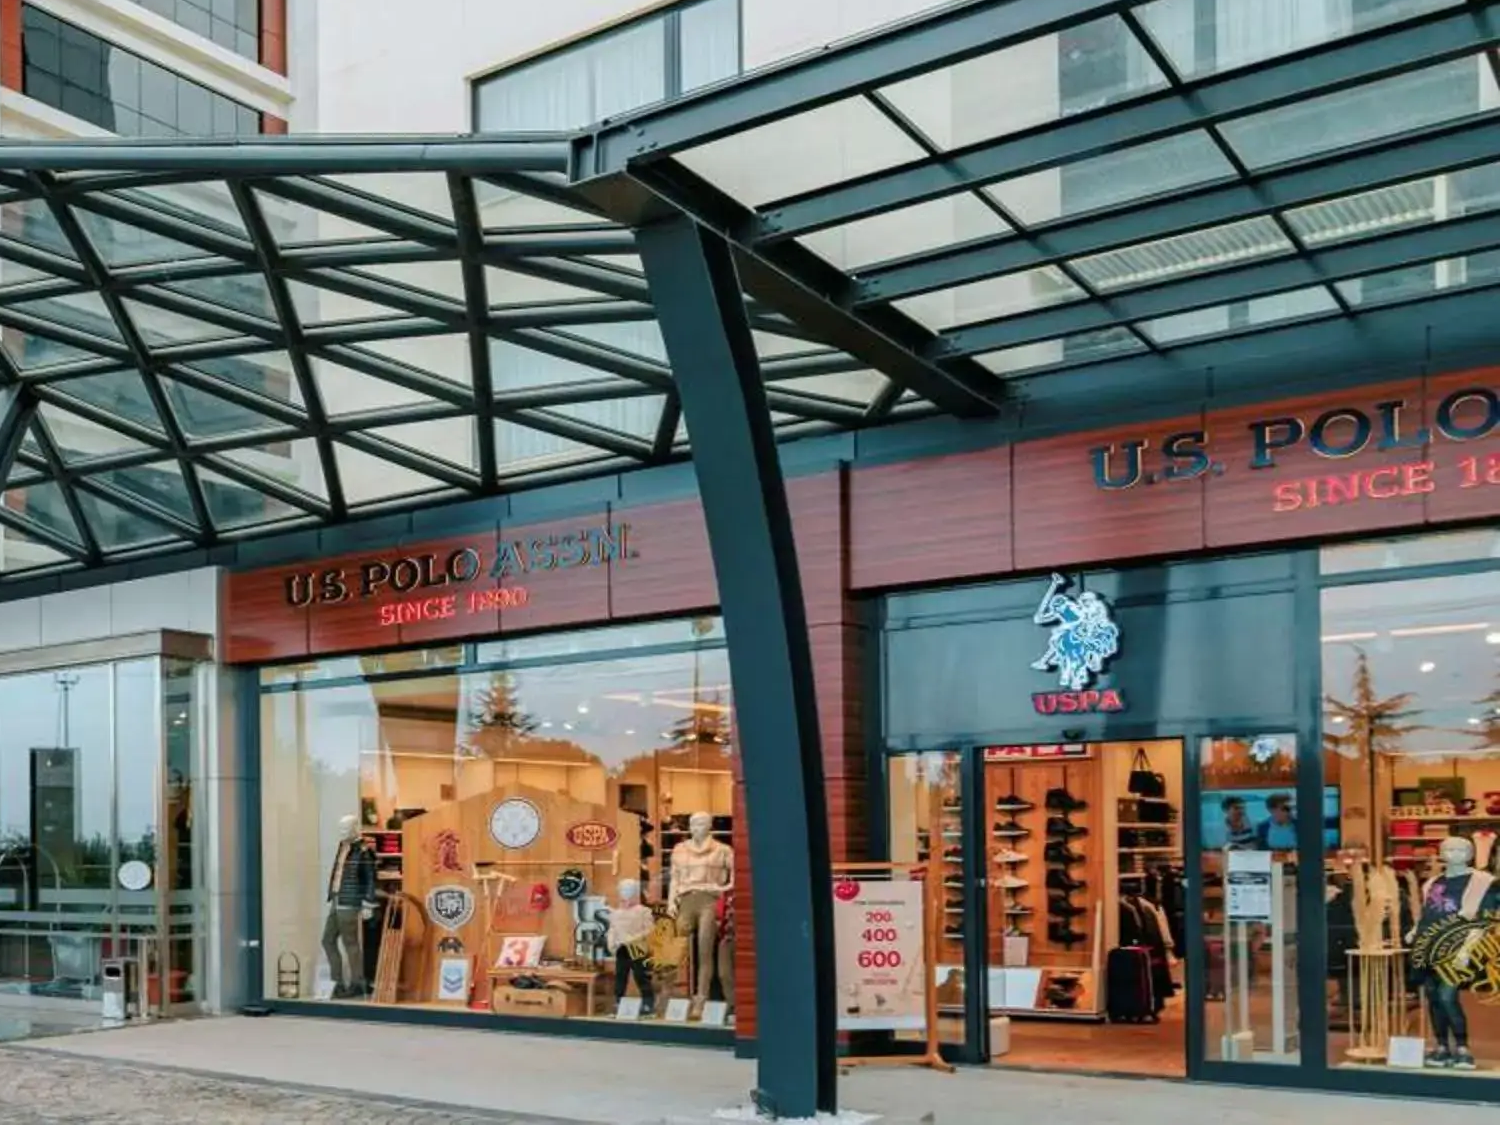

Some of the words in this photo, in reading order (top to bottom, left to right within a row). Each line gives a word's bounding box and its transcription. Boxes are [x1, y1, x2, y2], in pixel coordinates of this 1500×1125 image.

[1090, 430, 1227, 490] U.S.
[1248, 386, 1500, 471] POLO
[1273, 461, 1436, 512] SINCE
[360, 548, 481, 597] POLO
[380, 594, 455, 626] SINCE
[1031, 689, 1124, 715] USPA
[862, 928, 897, 942] 400
[858, 950, 901, 968] 600
